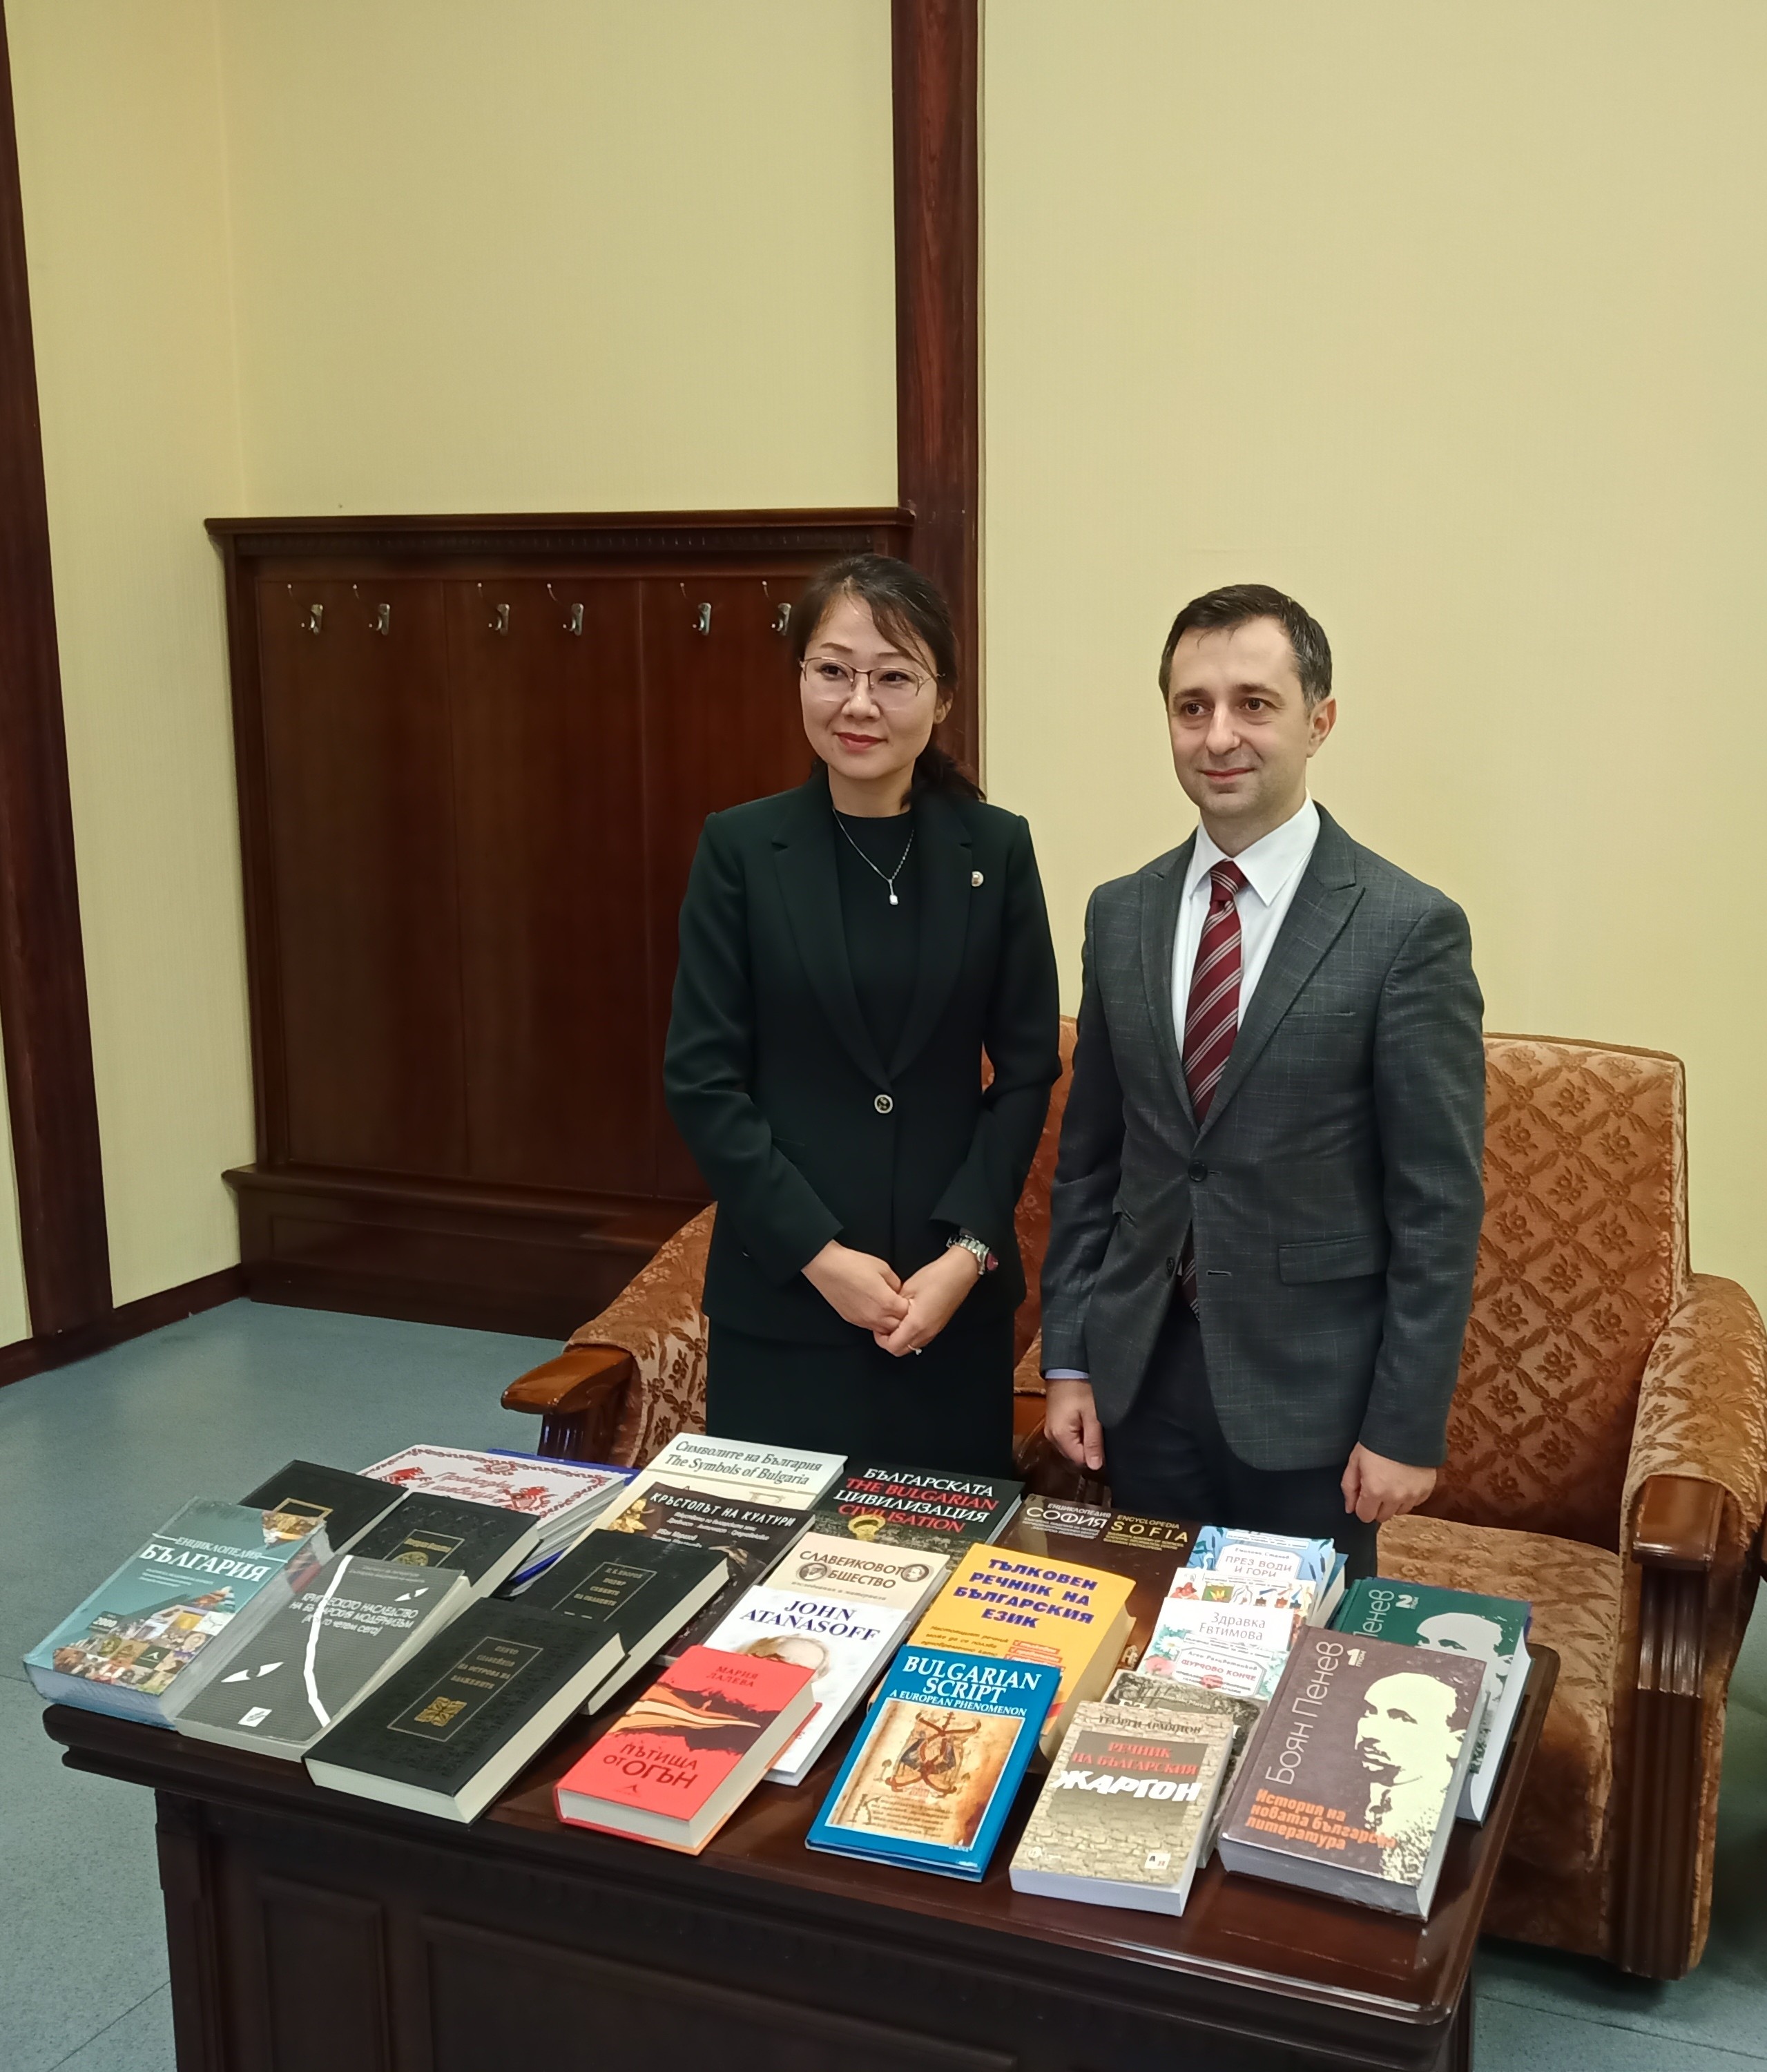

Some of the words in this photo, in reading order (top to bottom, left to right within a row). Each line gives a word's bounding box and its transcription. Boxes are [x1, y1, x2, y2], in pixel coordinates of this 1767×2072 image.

[665, 1454, 688, 1467] The
[688, 1457, 742, 1476] Symbols
[742, 1465, 757, 1478] of
[757, 1467, 810, 1486] Bulgaria
[675, 1441, 744, 1461] Символите
[746, 1452, 760, 1463] на
[761, 1453, 823, 1473] България
[845, 1477, 882, 1493] THE
[885, 1485, 999, 1510] BULGARIAN
[863, 1468, 994, 1497] БЪЛГАРСКАТА
[650, 1493, 722, 1515] КРЪСТОПЪТ
[721, 1507, 737, 1518] НА
[741, 1510, 796, 1528] КУЛТУРИ
[833, 1490, 990, 1523] ЦИВИЛИЗАЦИЯ
[1026, 1507, 1108, 1528] СОФИЯ
[1047, 1504, 1112, 1518] ЕНЦИКЛОПЕДИЯ
[1111, 1521, 1188, 1542] SOFIA
[1117, 1515, 1179, 1529] ENCYCLOPEDIA
[175, 1537, 262, 1560] ЕНЦИКЛОПЕДИЯ
[139, 1544, 271, 1582] БЪЛГАРИЯ
[987, 1559, 1098, 1591] ТЪЛКОВЕН
[1225, 1555, 1254, 1566] ПРЕЗ
[1259, 1560, 1293, 1572] ВОДИ
[1246, 1567, 1277, 1577] ГОРИ
[969, 1572, 1054, 1597] РЕЧНИК
[1061, 1591, 1091, 1606] НА
[1396, 1594, 1413, 1609] 2
[784, 1601, 856, 1621] JOHN
[953, 1586, 1094, 1624] БЪЛГАРСКИЯ
[981, 1608, 1041, 1629] ЕЗИК
[740, 1609, 880, 1640] ATANASOFF
[1211, 1612, 1266, 1629] Здравка
[715, 1666, 760, 1680] МАРИЯ
[902, 1656, 1042, 1691] BULGARIAN
[889, 1689, 898, 1698] A
[899, 1690, 954, 1707] EUROPEAN
[954, 1699, 1028, 1717] PHENOMENON
[923, 1677, 1007, 1704] SCRIPT
[1265, 1721, 1313, 1785] Боян
[1292, 1641, 1344, 1718] Пенев
[619, 1743, 697, 1771] ПЪТИЩА
[1072, 1752, 1093, 1765] НА
[1098, 1756, 1199, 1776] БЪЛГАРСКИЯ
[1108, 1742, 1172, 1758] РЕЧНИК
[603, 1754, 626, 1767] от
[622, 1761, 699, 1789] ОГЪН
[1049, 1770, 1203, 1802] ЖАРГОН
[1251, 1804, 1309, 1827] новата
[1255, 1788, 1325, 1816] История
[1326, 1807, 1346, 1822] на
[1245, 1816, 1346, 1850] литература
